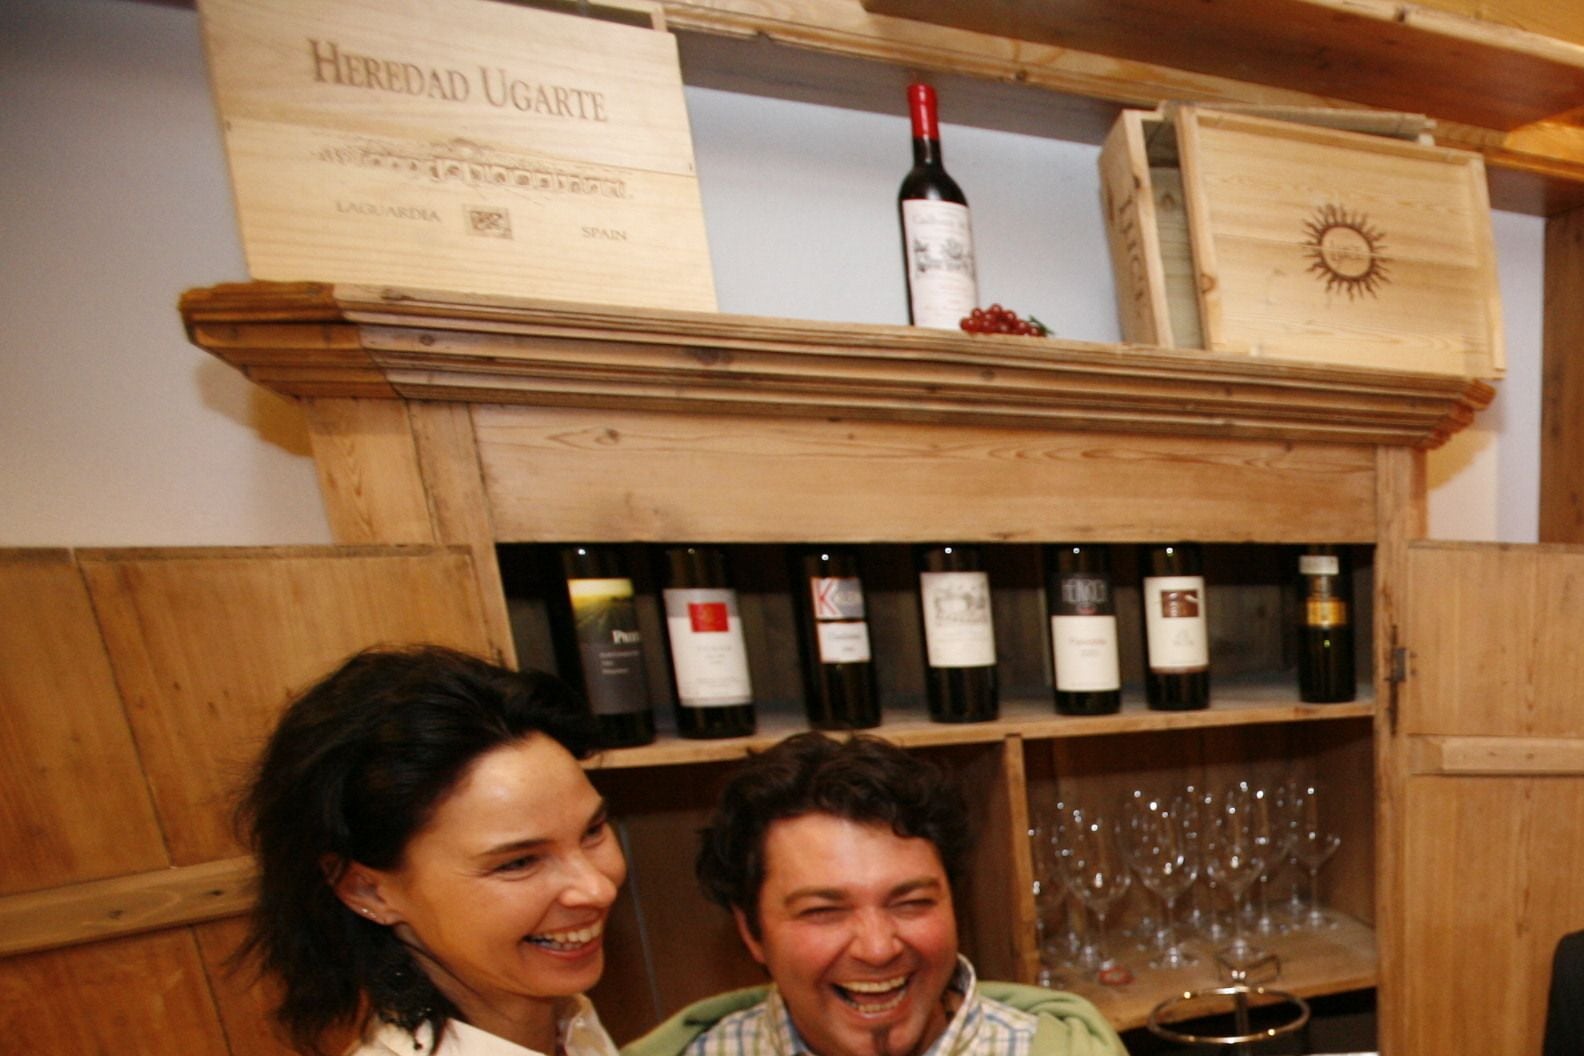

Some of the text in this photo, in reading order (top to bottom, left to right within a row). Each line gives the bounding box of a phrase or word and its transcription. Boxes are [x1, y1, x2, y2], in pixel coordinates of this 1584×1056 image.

[307, 37, 609, 123] HEREDAD UGARTE
[336, 201, 442, 223] LAGUARDIA
[581, 225, 628, 241] SPAIN
